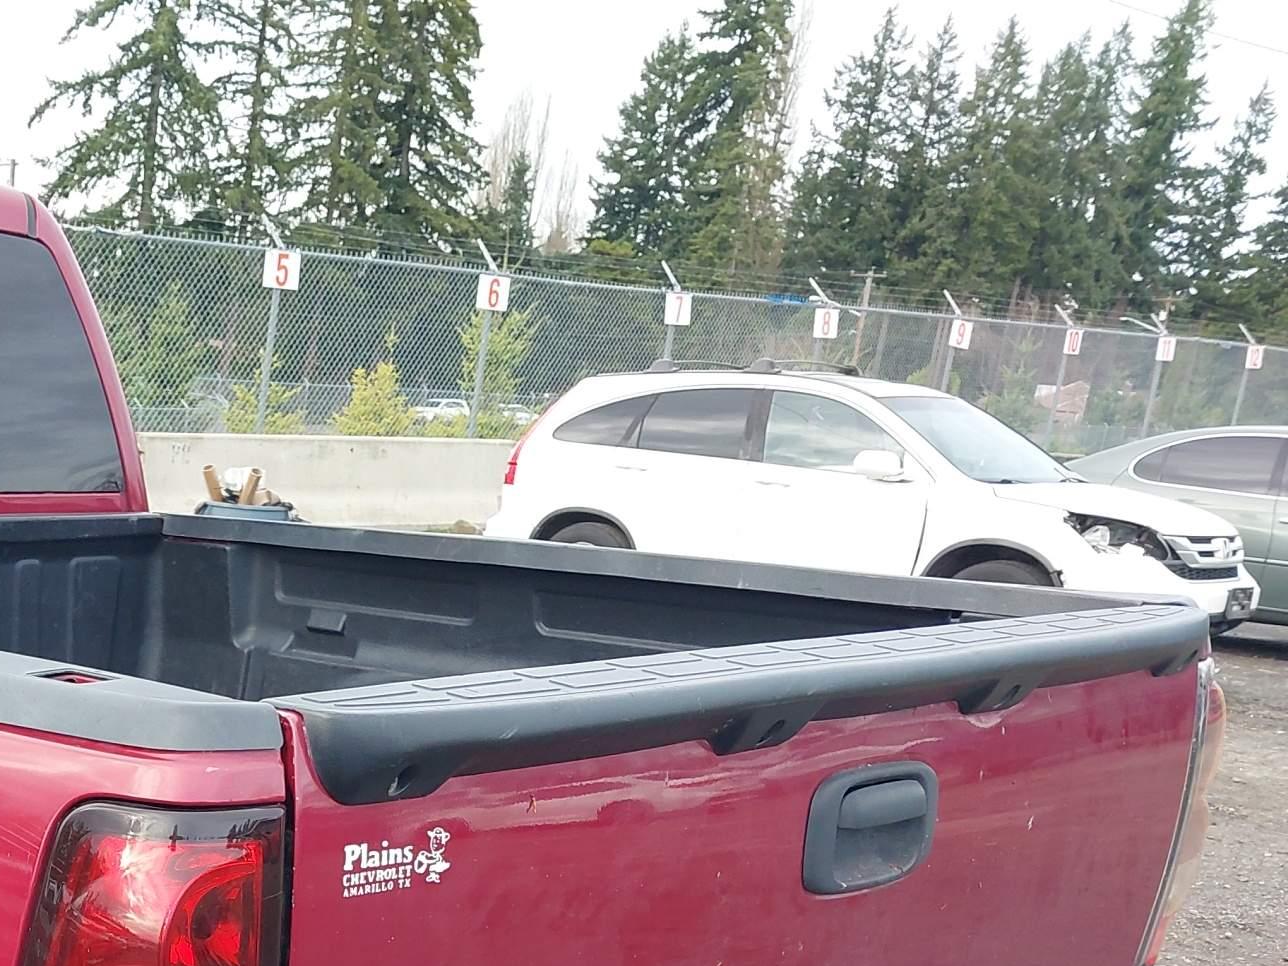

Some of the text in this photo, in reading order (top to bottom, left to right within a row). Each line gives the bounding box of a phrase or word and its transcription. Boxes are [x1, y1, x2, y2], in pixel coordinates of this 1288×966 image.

[275, 253, 289, 287] 5
[488, 278, 500, 308] 6
[675, 295, 684, 323] 7
[822, 311, 831, 336] 8
[956, 322, 966, 346] 9
[1067, 330, 1080, 353] 10
[1161, 339, 1172, 360] 11
[1249, 347, 1261, 368] 12
[343, 840, 413, 871] Plains
[342, 865, 413, 887] CHEVROLET
[343, 878, 411, 898] AMARILLO TX
